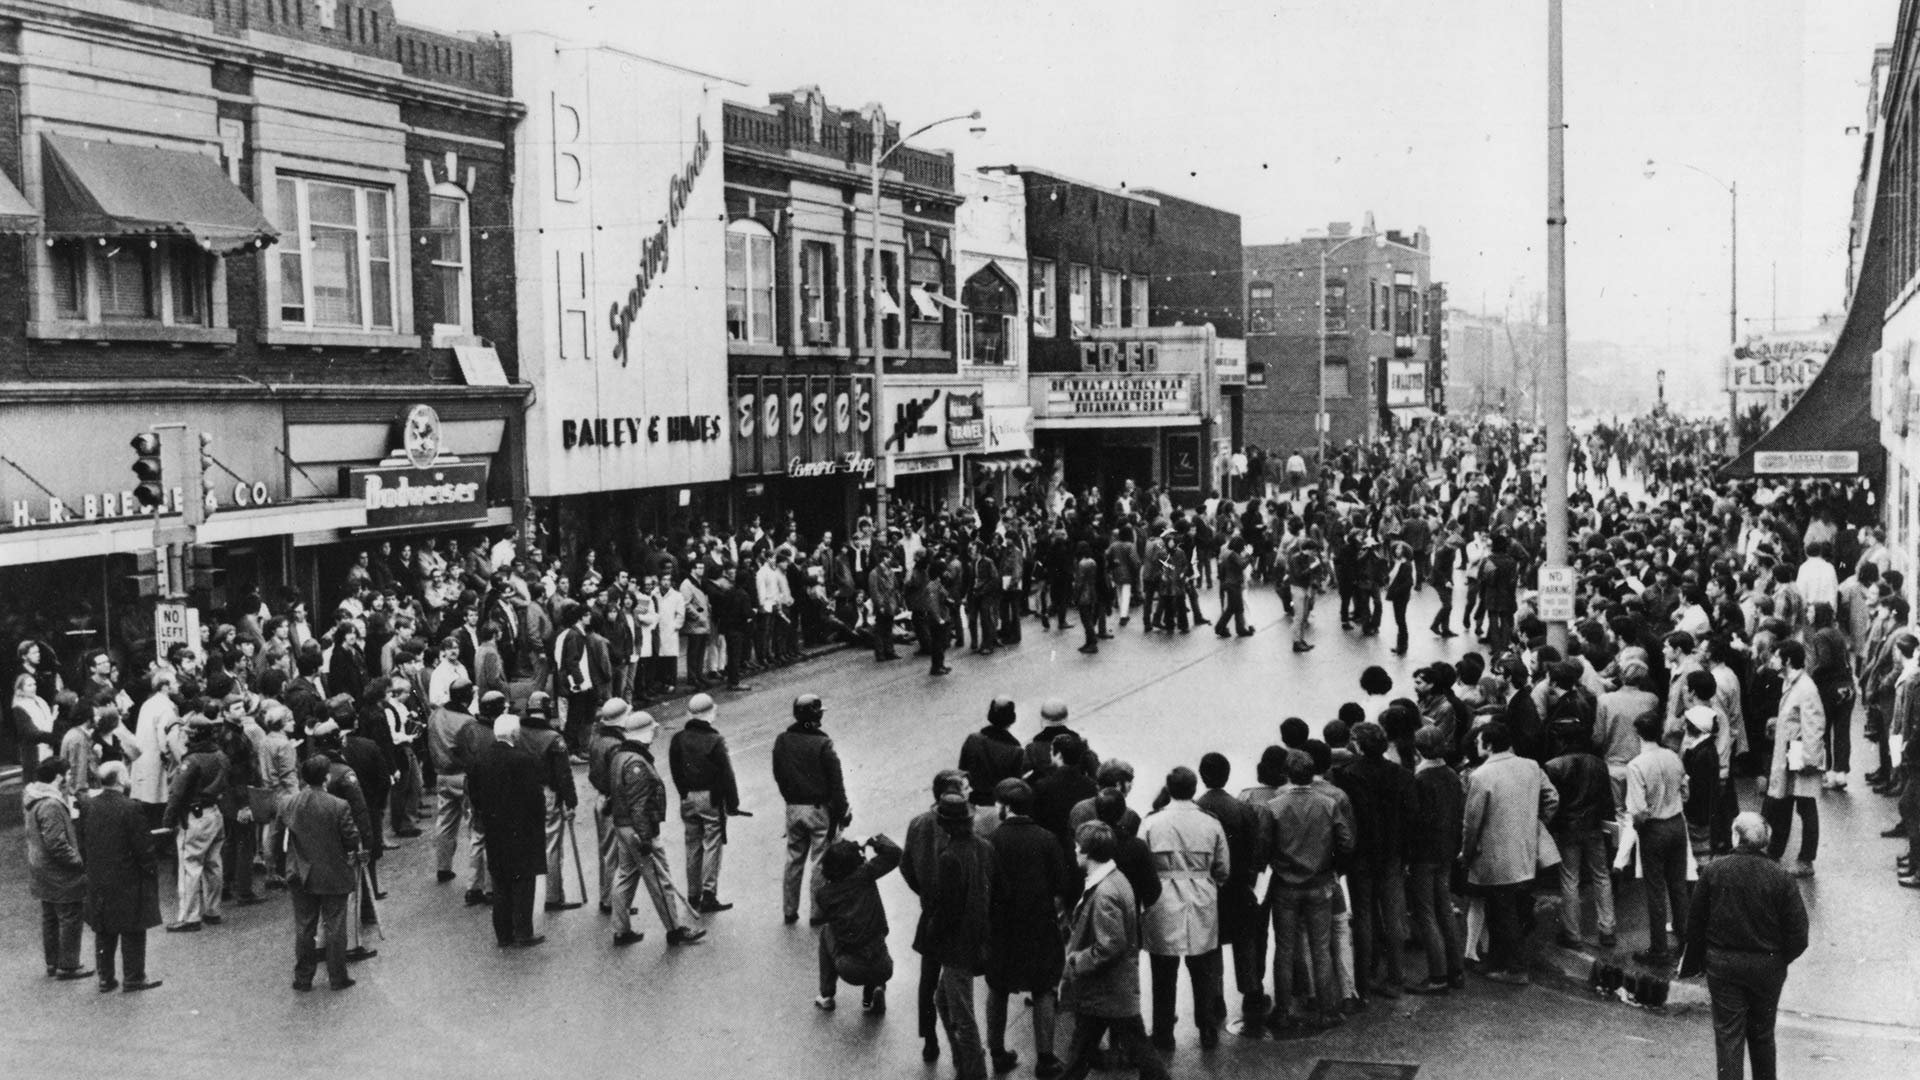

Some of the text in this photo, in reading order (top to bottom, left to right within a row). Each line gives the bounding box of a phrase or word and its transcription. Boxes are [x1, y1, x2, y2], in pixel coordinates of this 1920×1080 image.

[609, 114, 711, 368] Sporting Goods
[1069, 390, 1177, 401] VANESSA REDGRAVE
[1135, 401, 1164, 411] YORK
[562, 415, 721, 450] BAILEY & HIMES
[951, 424, 984, 439] TRAVEL
[787, 455, 836, 478] Camera
[843, 451, 876, 479] Shop
[364, 472, 479, 510] Budweiser
[13, 499, 36, 528] H.
[49, 496, 71, 524] R.
[234, 478, 272, 507] CO.
[1549, 571, 1562, 581] NO
[163, 610, 179, 623] NO
[161, 626, 183, 638] LEFT
